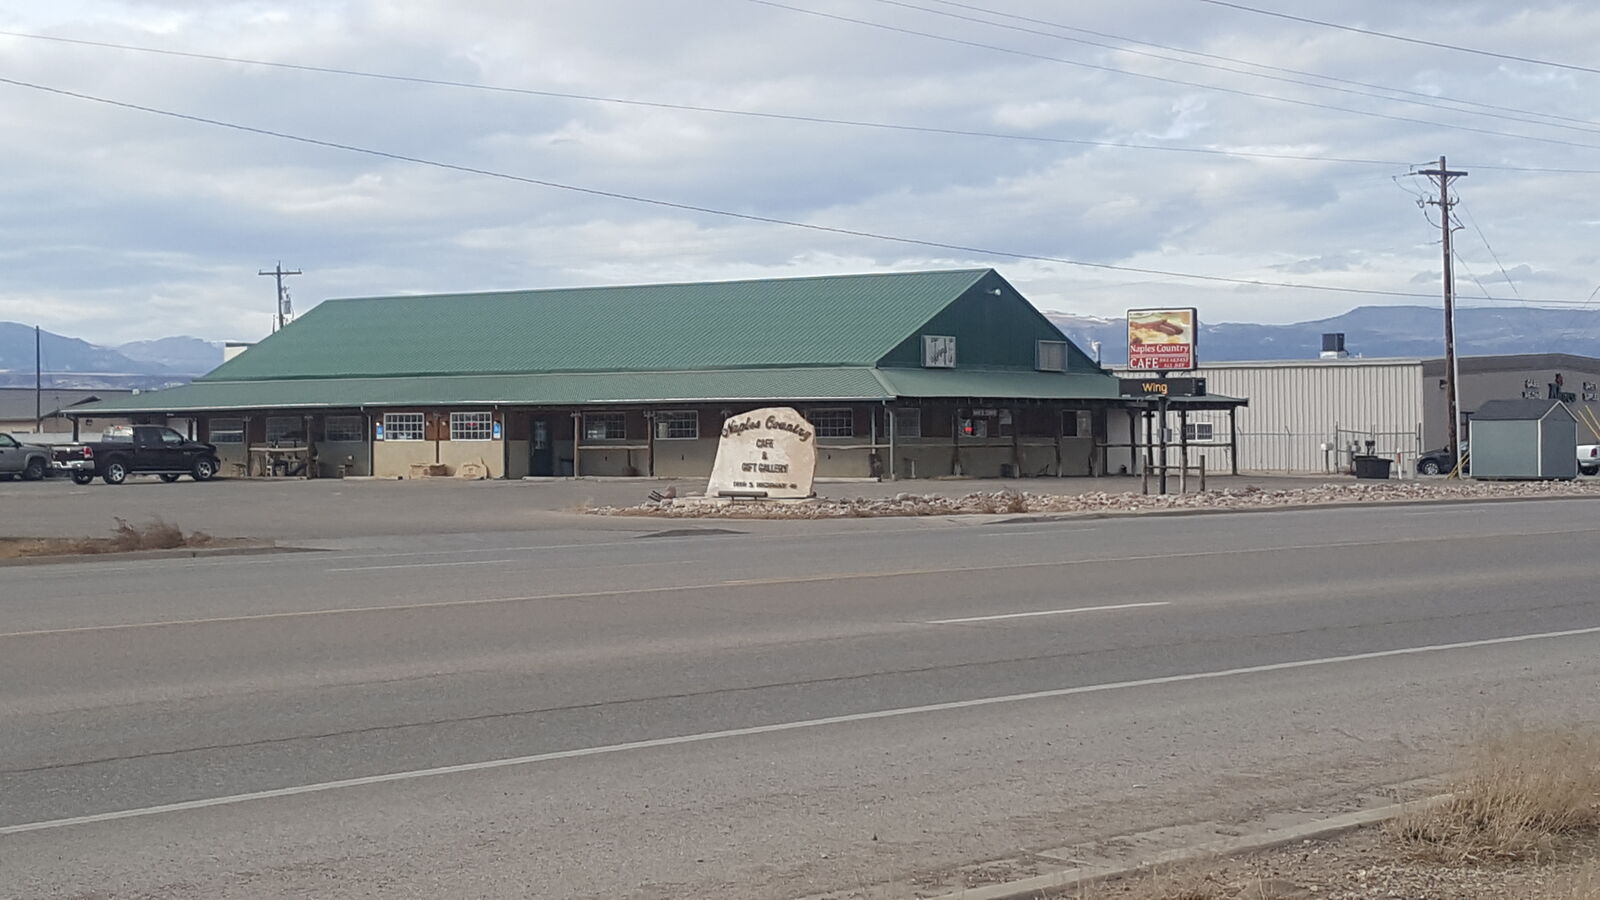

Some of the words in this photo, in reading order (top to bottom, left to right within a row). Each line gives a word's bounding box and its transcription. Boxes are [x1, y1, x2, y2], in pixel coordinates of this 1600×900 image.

[1130, 345, 1155, 354] Naples
[1156, 344, 1188, 353] Country
[1130, 358, 1159, 368] CAFE
[1142, 383, 1168, 394] Wing
[721, 417, 760, 438] Naples
[765, 415, 812, 442] Country
[756, 438, 774, 448] CAFE
[762, 451, 768, 460] &
[742, 463, 757, 472] GIFT
[758, 463, 788, 473] GALLERY
